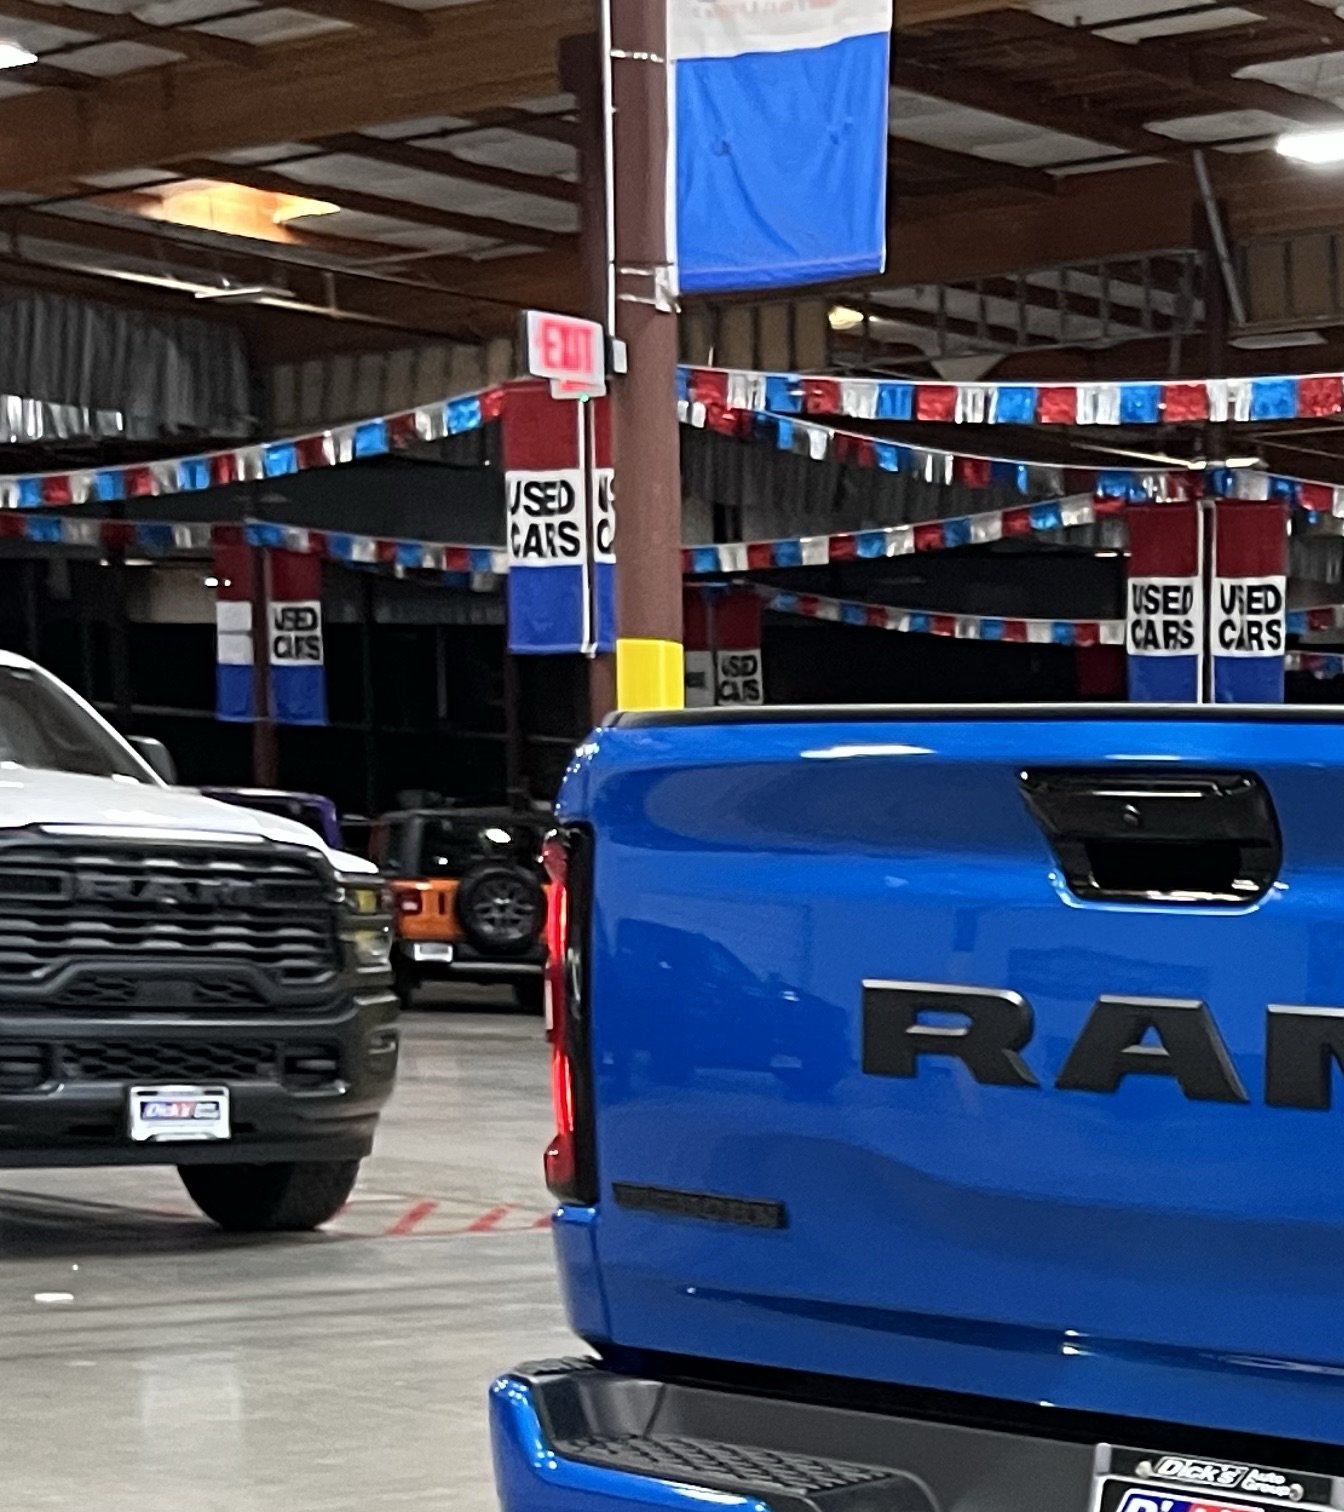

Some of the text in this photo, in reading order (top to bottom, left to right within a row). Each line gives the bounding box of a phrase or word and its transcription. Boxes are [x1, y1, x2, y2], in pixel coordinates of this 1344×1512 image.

[541, 318, 593, 373] EXIT
[510, 480, 575, 517] USED
[511, 520, 580, 558] CARS
[1131, 583, 1194, 615] USED
[1219, 583, 1282, 615] USED
[1130, 619, 1195, 650] CARS
[1218, 619, 1282, 650] CARS
[1156, 1457, 1242, 1485] Dick's
